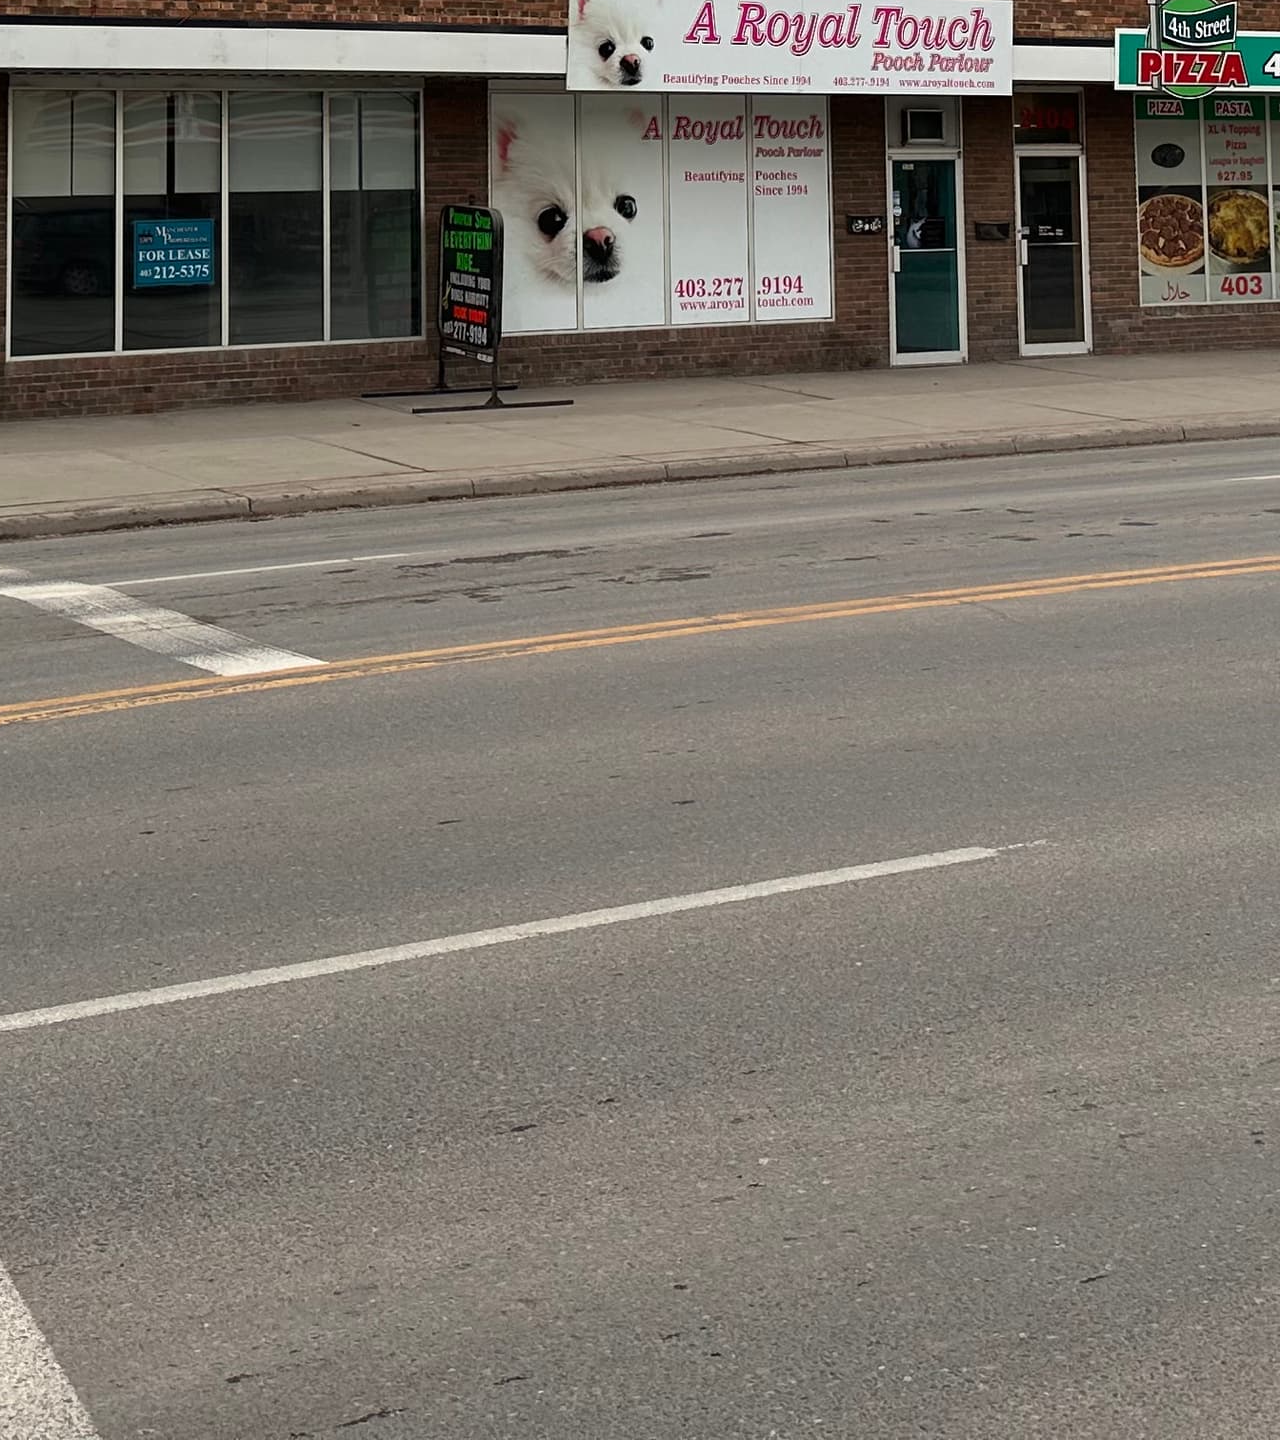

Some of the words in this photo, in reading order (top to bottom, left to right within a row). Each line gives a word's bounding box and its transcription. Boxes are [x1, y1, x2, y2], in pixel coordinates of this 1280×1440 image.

[683, 0, 721, 45] A
[730, 1, 861, 56] Royal
[871, 7, 996, 51] Touch
[1168, 19, 1191, 40] 4th
[1194, 14, 1231, 40] Street
[871, 51, 925, 72] Pooch
[928, 53, 994, 73] Parlour
[1138, 50, 1249, 87] PIZZA
[663, 73, 719, 86] Beautifying
[721, 74, 761, 86] Pooches
[763, 75, 789, 86] Since
[899, 78, 995, 89] www.aroyaltouch.com
[1149, 100, 1183, 115] PIZZA
[1215, 101, 1252, 115] PASTA
[641, 116, 663, 140] A
[671, 114, 745, 145] Royal
[754, 114, 824, 140] Touch
[755, 147, 786, 158] Pooch
[787, 147, 825, 158] Parlour
[684, 170, 745, 183] Beautifying
[755, 170, 798, 181] Pooches
[755, 185, 783, 196] Since
[787, 184, 808, 195] 1994
[139, 249, 166, 262] FOR
[169, 248, 211, 261] LEASE
[153, 264, 210, 279] 212-5375
[1161, 280, 1191, 301] حلال
[1221, 275, 1263, 296] 403
